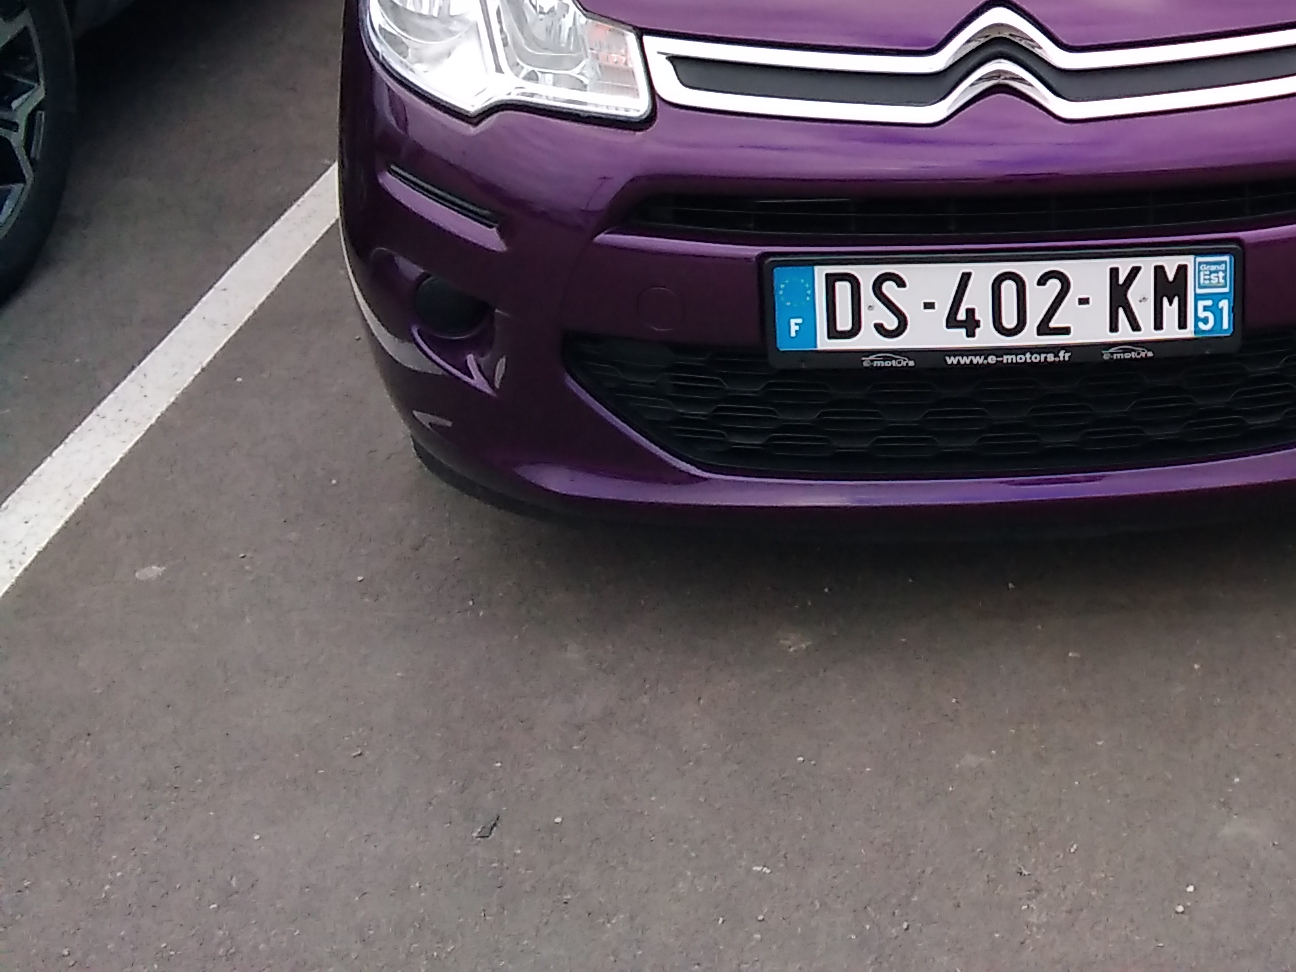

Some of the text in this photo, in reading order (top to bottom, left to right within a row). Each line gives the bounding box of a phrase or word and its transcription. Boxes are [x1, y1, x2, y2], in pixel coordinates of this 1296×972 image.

[1200, 271, 1225, 286] Est
[824, 263, 1189, 341] DS-402-KM
[1197, 299, 1230, 332] 51
[789, 318, 804, 339] F
[945, 349, 1072, 367] www.e-motors.fr
